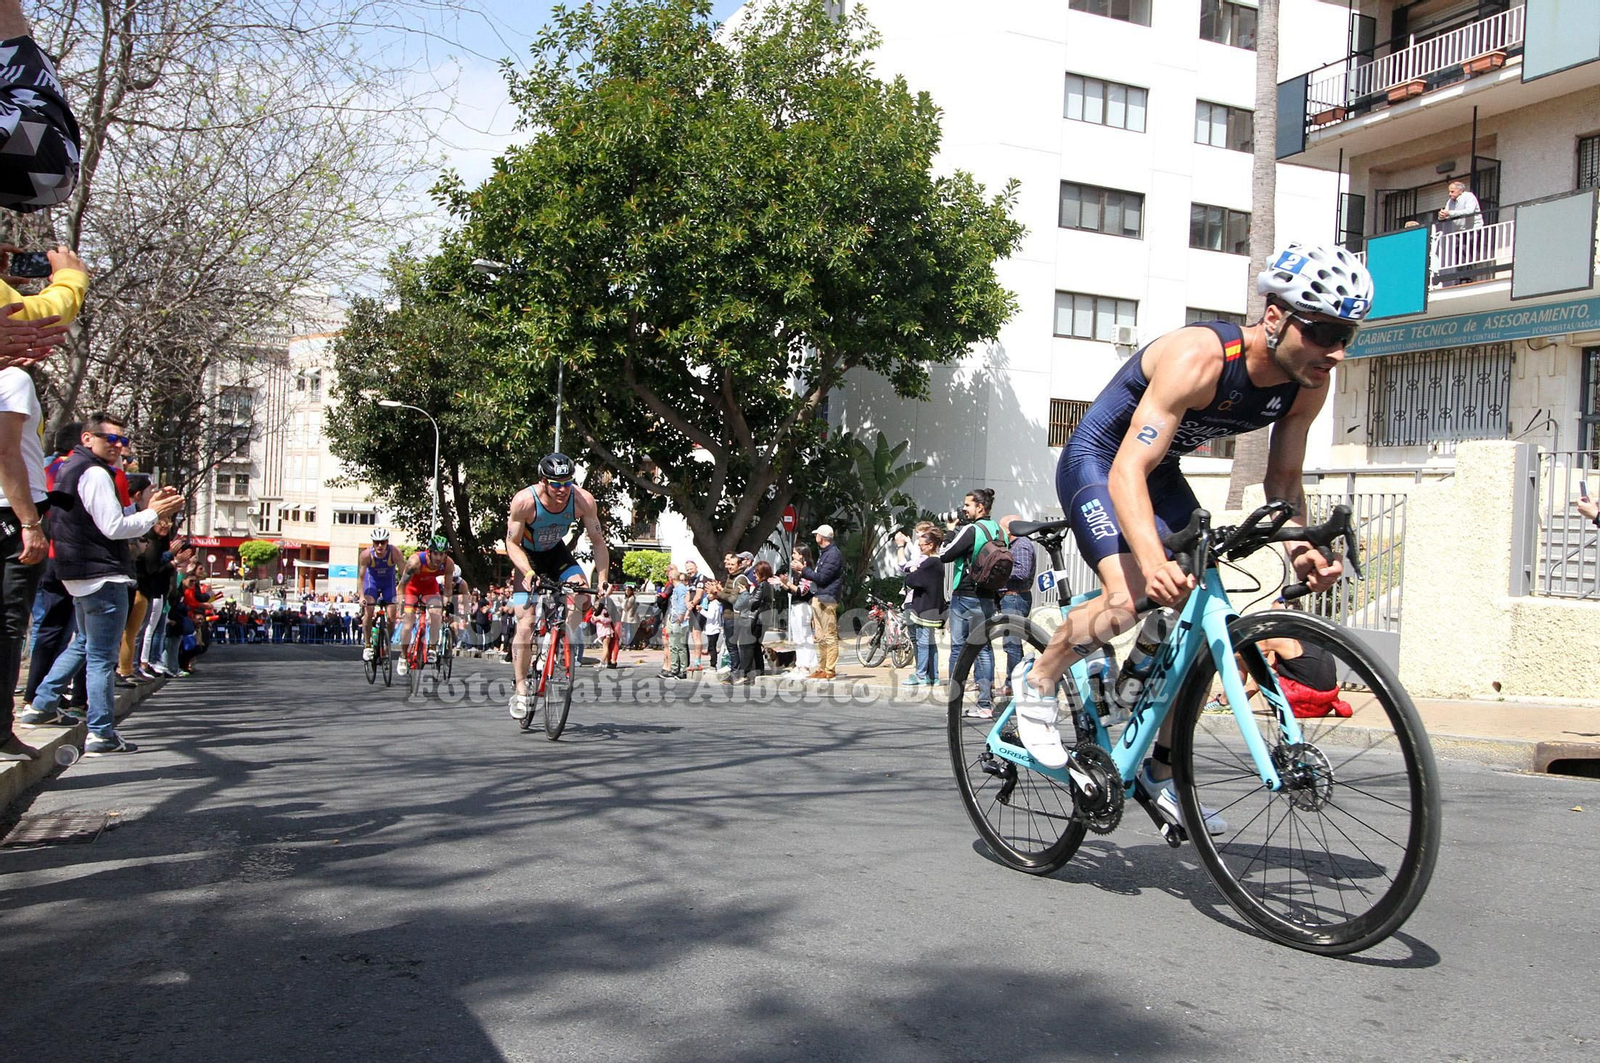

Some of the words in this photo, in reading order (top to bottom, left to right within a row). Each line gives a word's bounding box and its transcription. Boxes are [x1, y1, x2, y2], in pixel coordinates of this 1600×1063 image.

[1279, 253, 1302, 270] 2
[1348, 299, 1365, 318] 2
[1357, 329, 1406, 346] GABINETE
[1411, 321, 1458, 339] TÉCNICO
[1463, 318, 1477, 333] de
[1483, 304, 1590, 330] ASESORAMIENTO,
[1136, 425, 1158, 446] 2
[1042, 573, 1052, 588] 2
